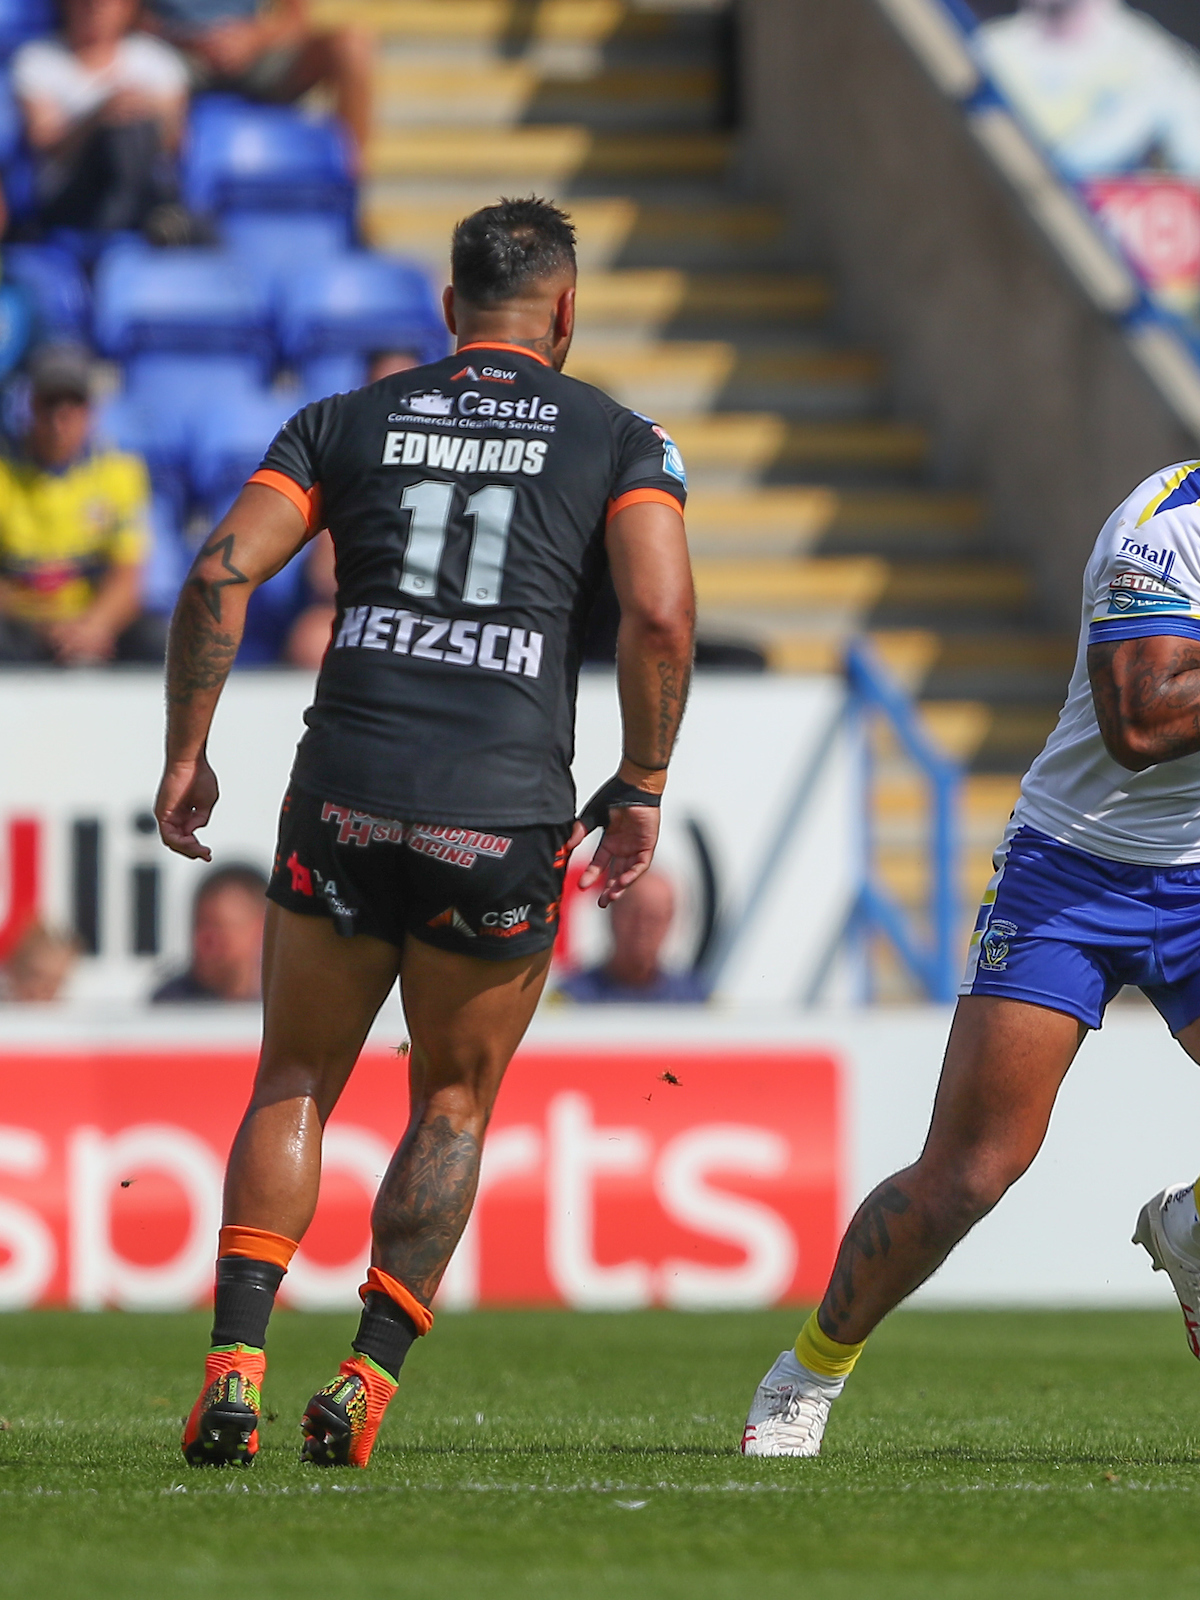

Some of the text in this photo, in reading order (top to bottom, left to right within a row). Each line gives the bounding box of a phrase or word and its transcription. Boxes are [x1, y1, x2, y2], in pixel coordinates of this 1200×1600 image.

[482, 366, 517, 380] CSW
[387, 412, 556, 433] Commercial Cleaning Services
[457, 391, 559, 421] Castle
[382, 430, 548, 475] EDWARDS
[398, 479, 517, 606] 11
[334, 605, 544, 679] NETZSCH
[372, 824, 477, 869] SUACING
[481, 903, 532, 928] CSW
